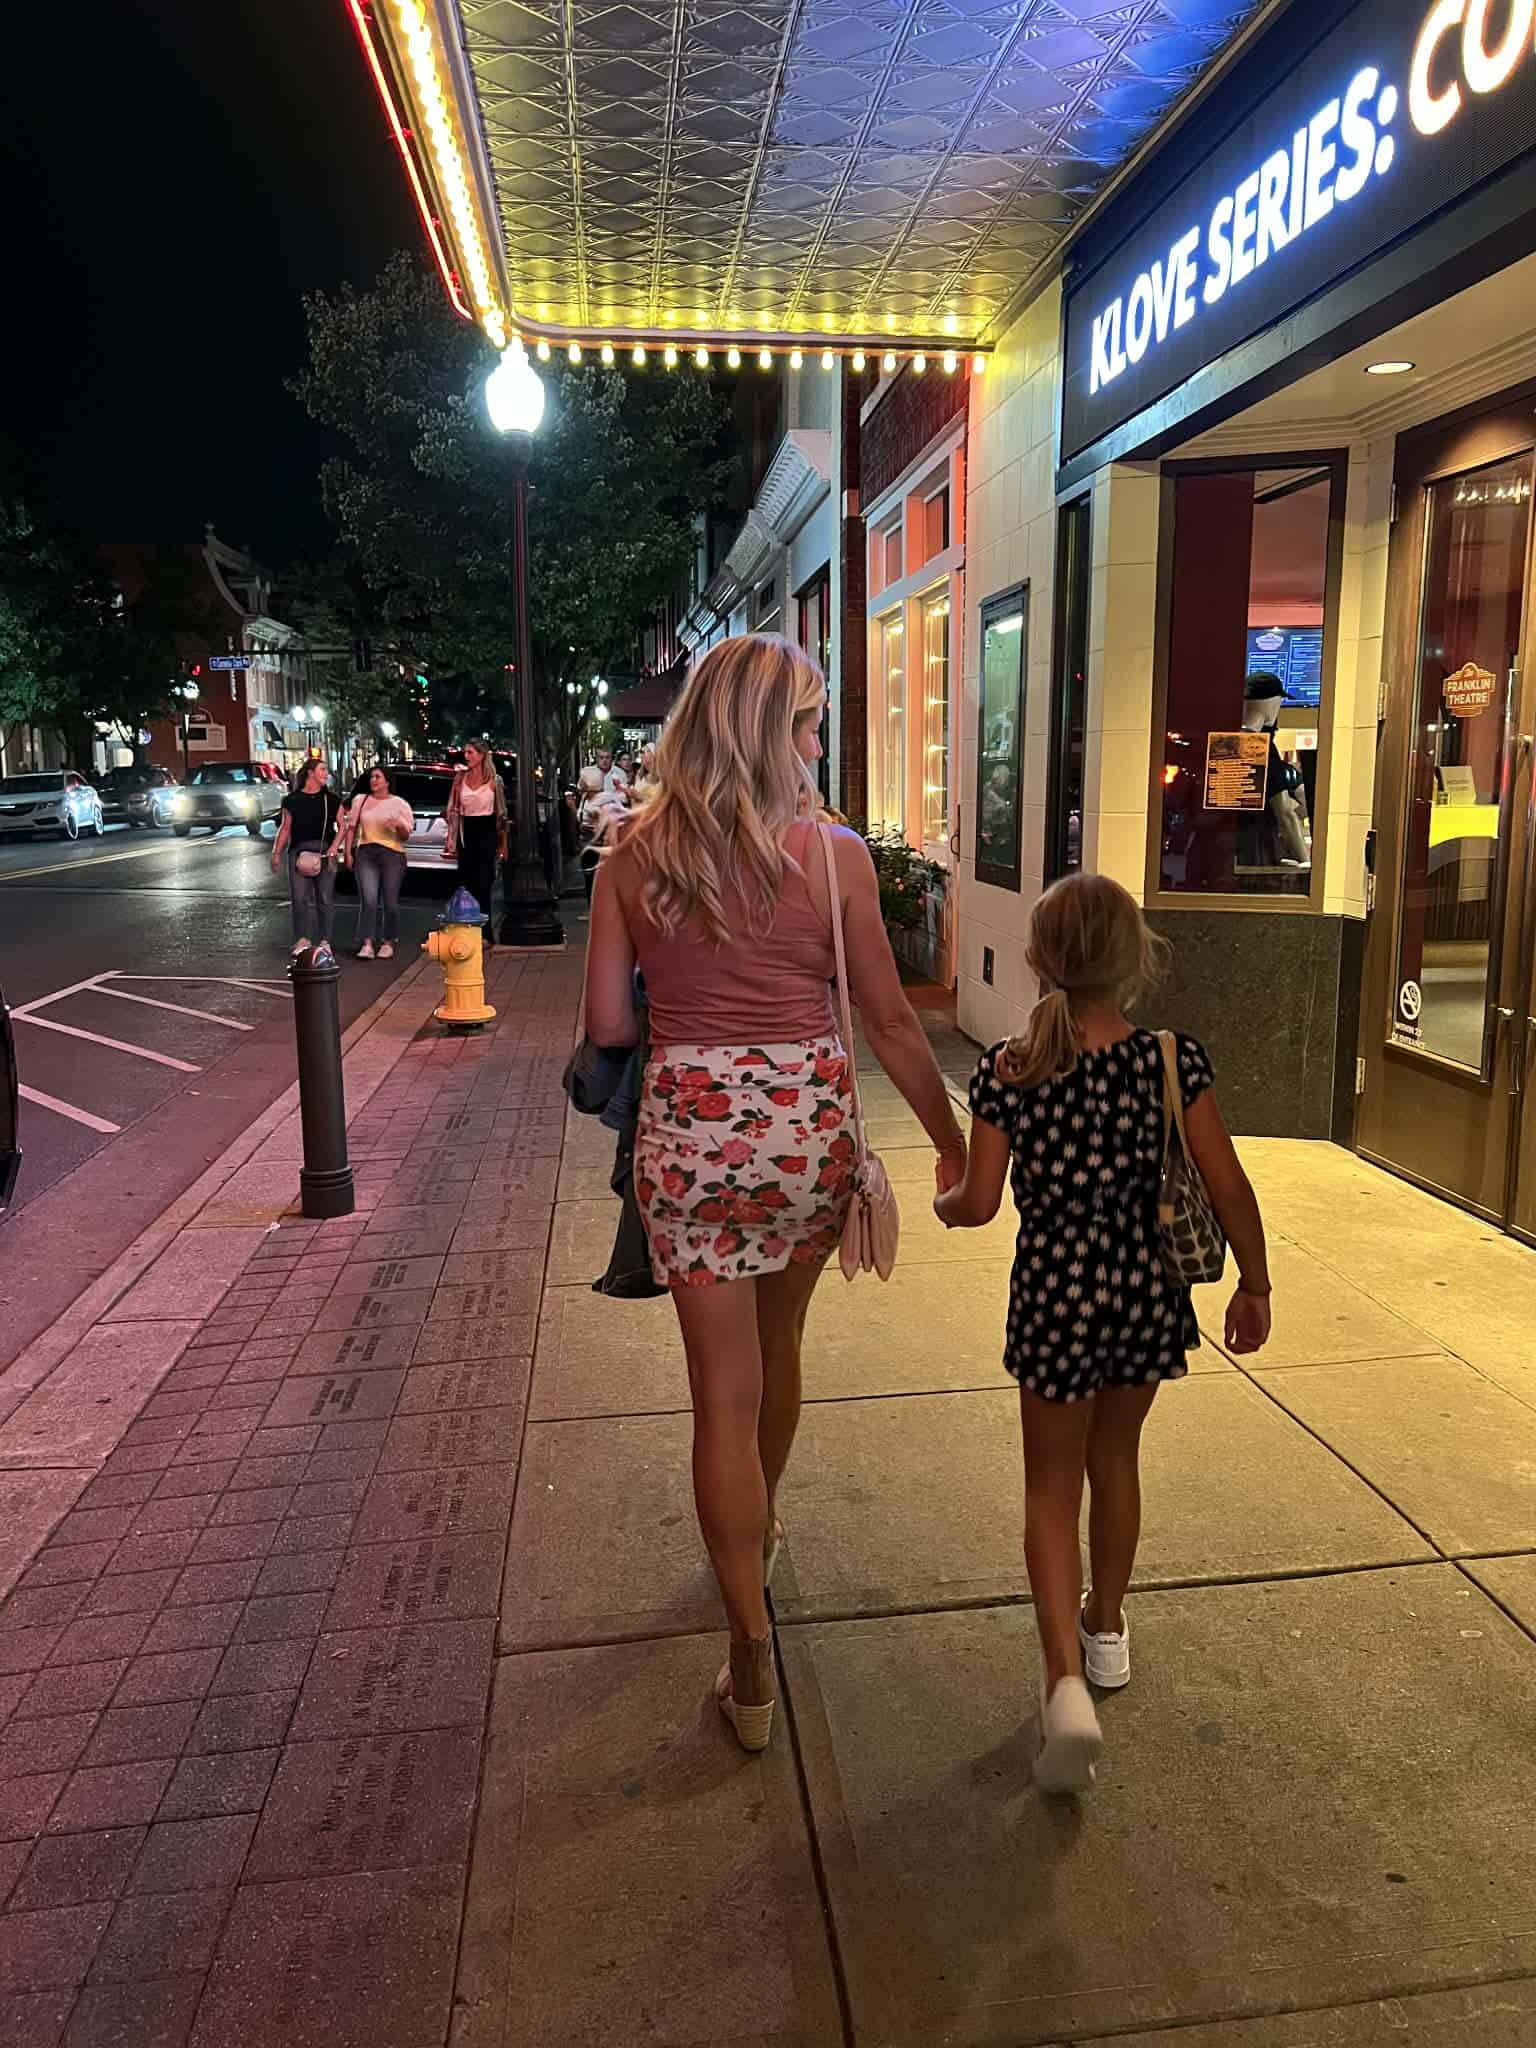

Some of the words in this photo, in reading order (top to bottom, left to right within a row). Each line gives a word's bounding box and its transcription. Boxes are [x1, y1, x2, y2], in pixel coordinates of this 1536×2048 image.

[1089, 224, 1201, 395] KLOVE
[1203, 66, 1398, 304] SERIES:
[1408, 0, 1536, 135] CO
[1447, 679, 1491, 692] FRANKLIN
[1448, 692, 1489, 705] THEATRE
